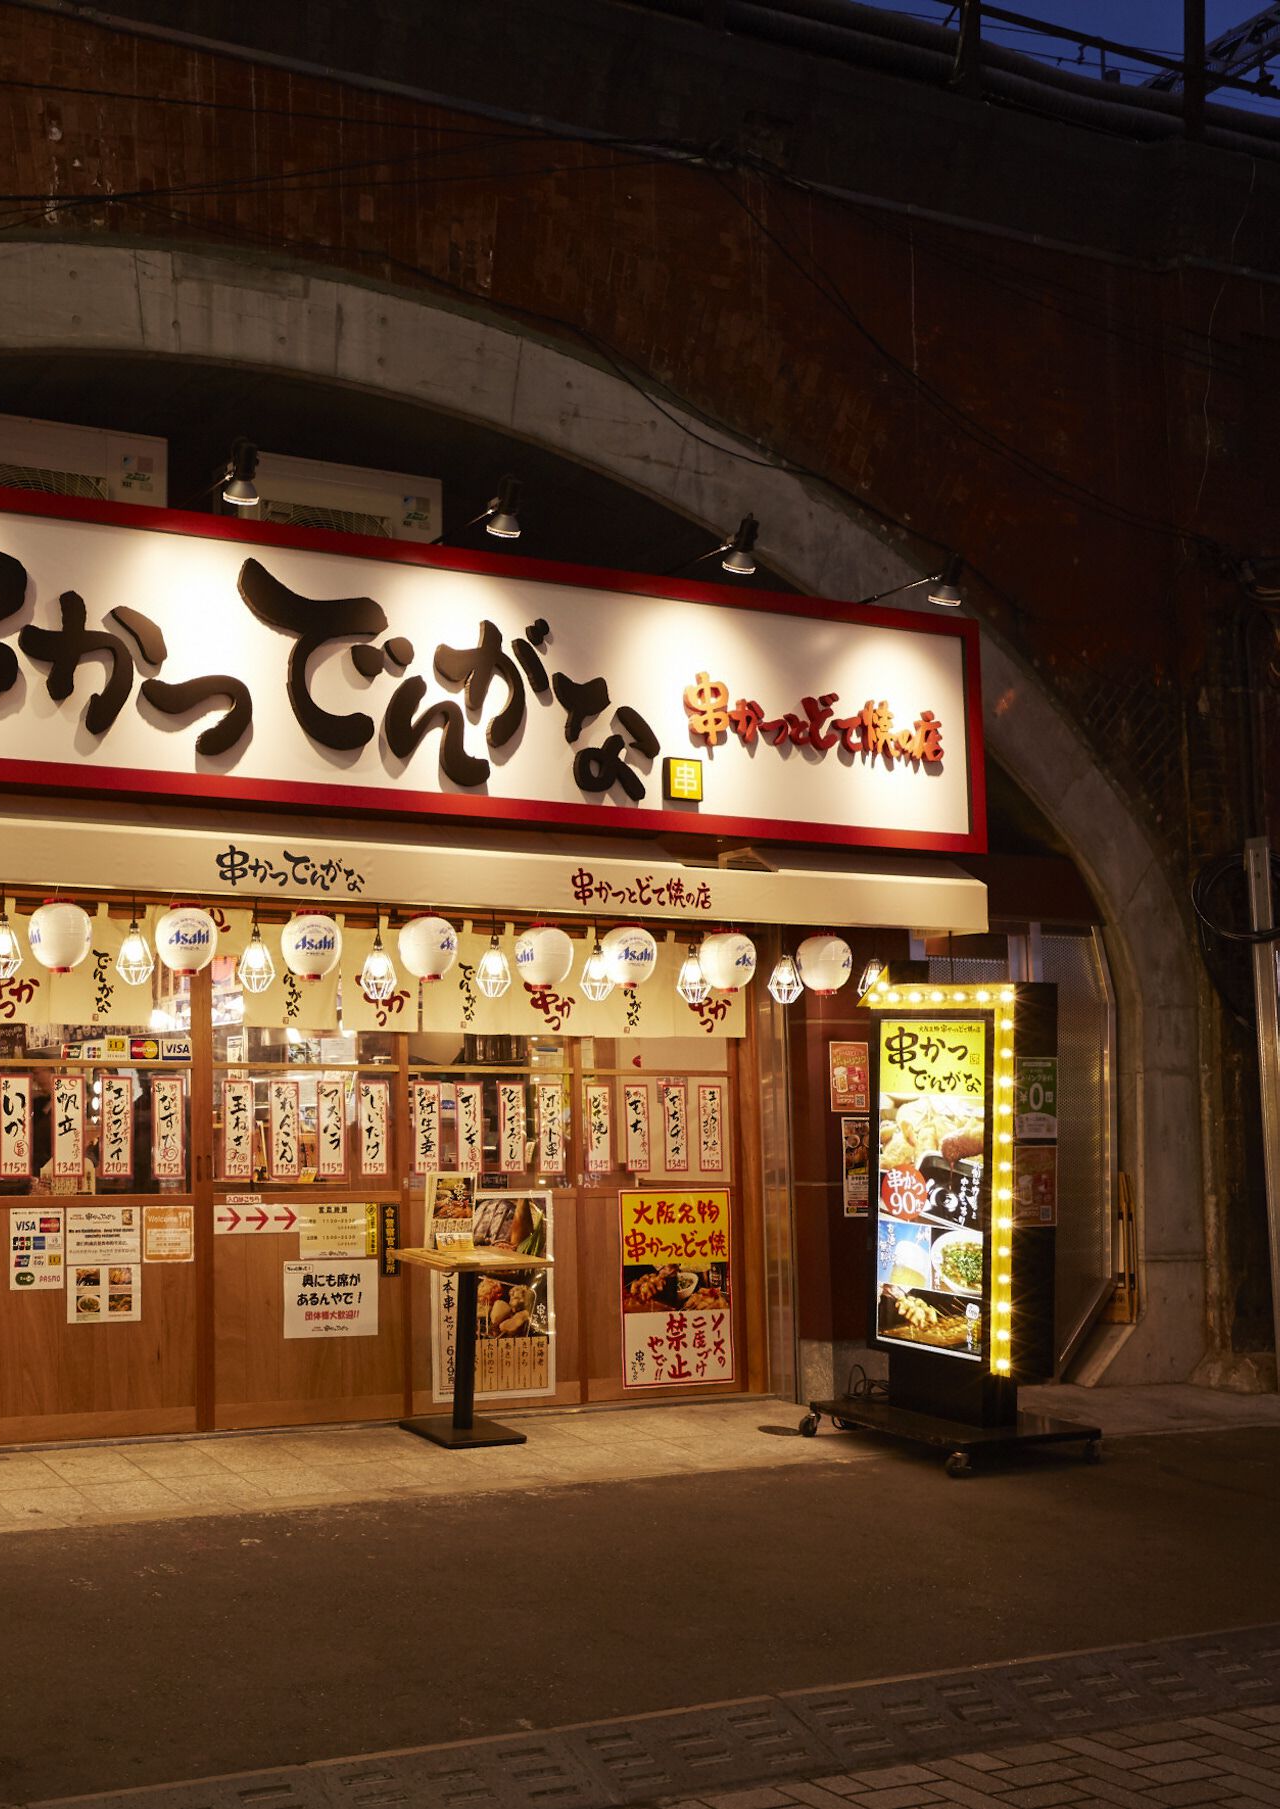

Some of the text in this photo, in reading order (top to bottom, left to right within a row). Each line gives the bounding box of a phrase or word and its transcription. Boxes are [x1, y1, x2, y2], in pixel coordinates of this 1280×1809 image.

[683, 671, 945, 762] 串かつとどて焼の店
[674, 763, 697, 796] 串
[215, 845, 365, 893] 串かつでんがな
[571, 868, 712, 909] 串かつとどて焼の店
[168, 928, 210, 946] Asahi
[294, 935, 335, 951] Asahi
[617, 946, 653, 963] Asahi
[93, 949, 115, 1014] でんがな
[282, 967, 303, 1019] んがな
[459, 962, 477, 1023] でんがな
[624, 989, 642, 1028] んがな
[166, 1044, 190, 1054] VISA
[885, 1026, 969, 1070] 串かつ
[908, 1066, 982, 1093] でんがな
[3, 1092, 26, 1138] いか
[56, 1092, 80, 1137] 帆立
[110, 1087, 126, 1160] エビフライ
[323, 1089, 341, 1150] アスパラ
[365, 1094, 380, 1160] しいたけ
[419, 1096, 436, 1155] 紅生姜
[628, 1099, 643, 1134] もち
[886, 1168, 925, 1195] 串かつ
[16, 1221, 37, 1231] VISA
[633, 1200, 720, 1225] 大阪名物
[625, 1228, 728, 1263] 串かつとどて焼
[302, 1273, 361, 1288] 奥にも席が
[487, 1342, 495, 1374] たけのこ
[666, 1313, 692, 1379] 禁止
[692, 1316, 712, 1377] 二度づけ
[711, 1312, 726, 1368] ソースの
